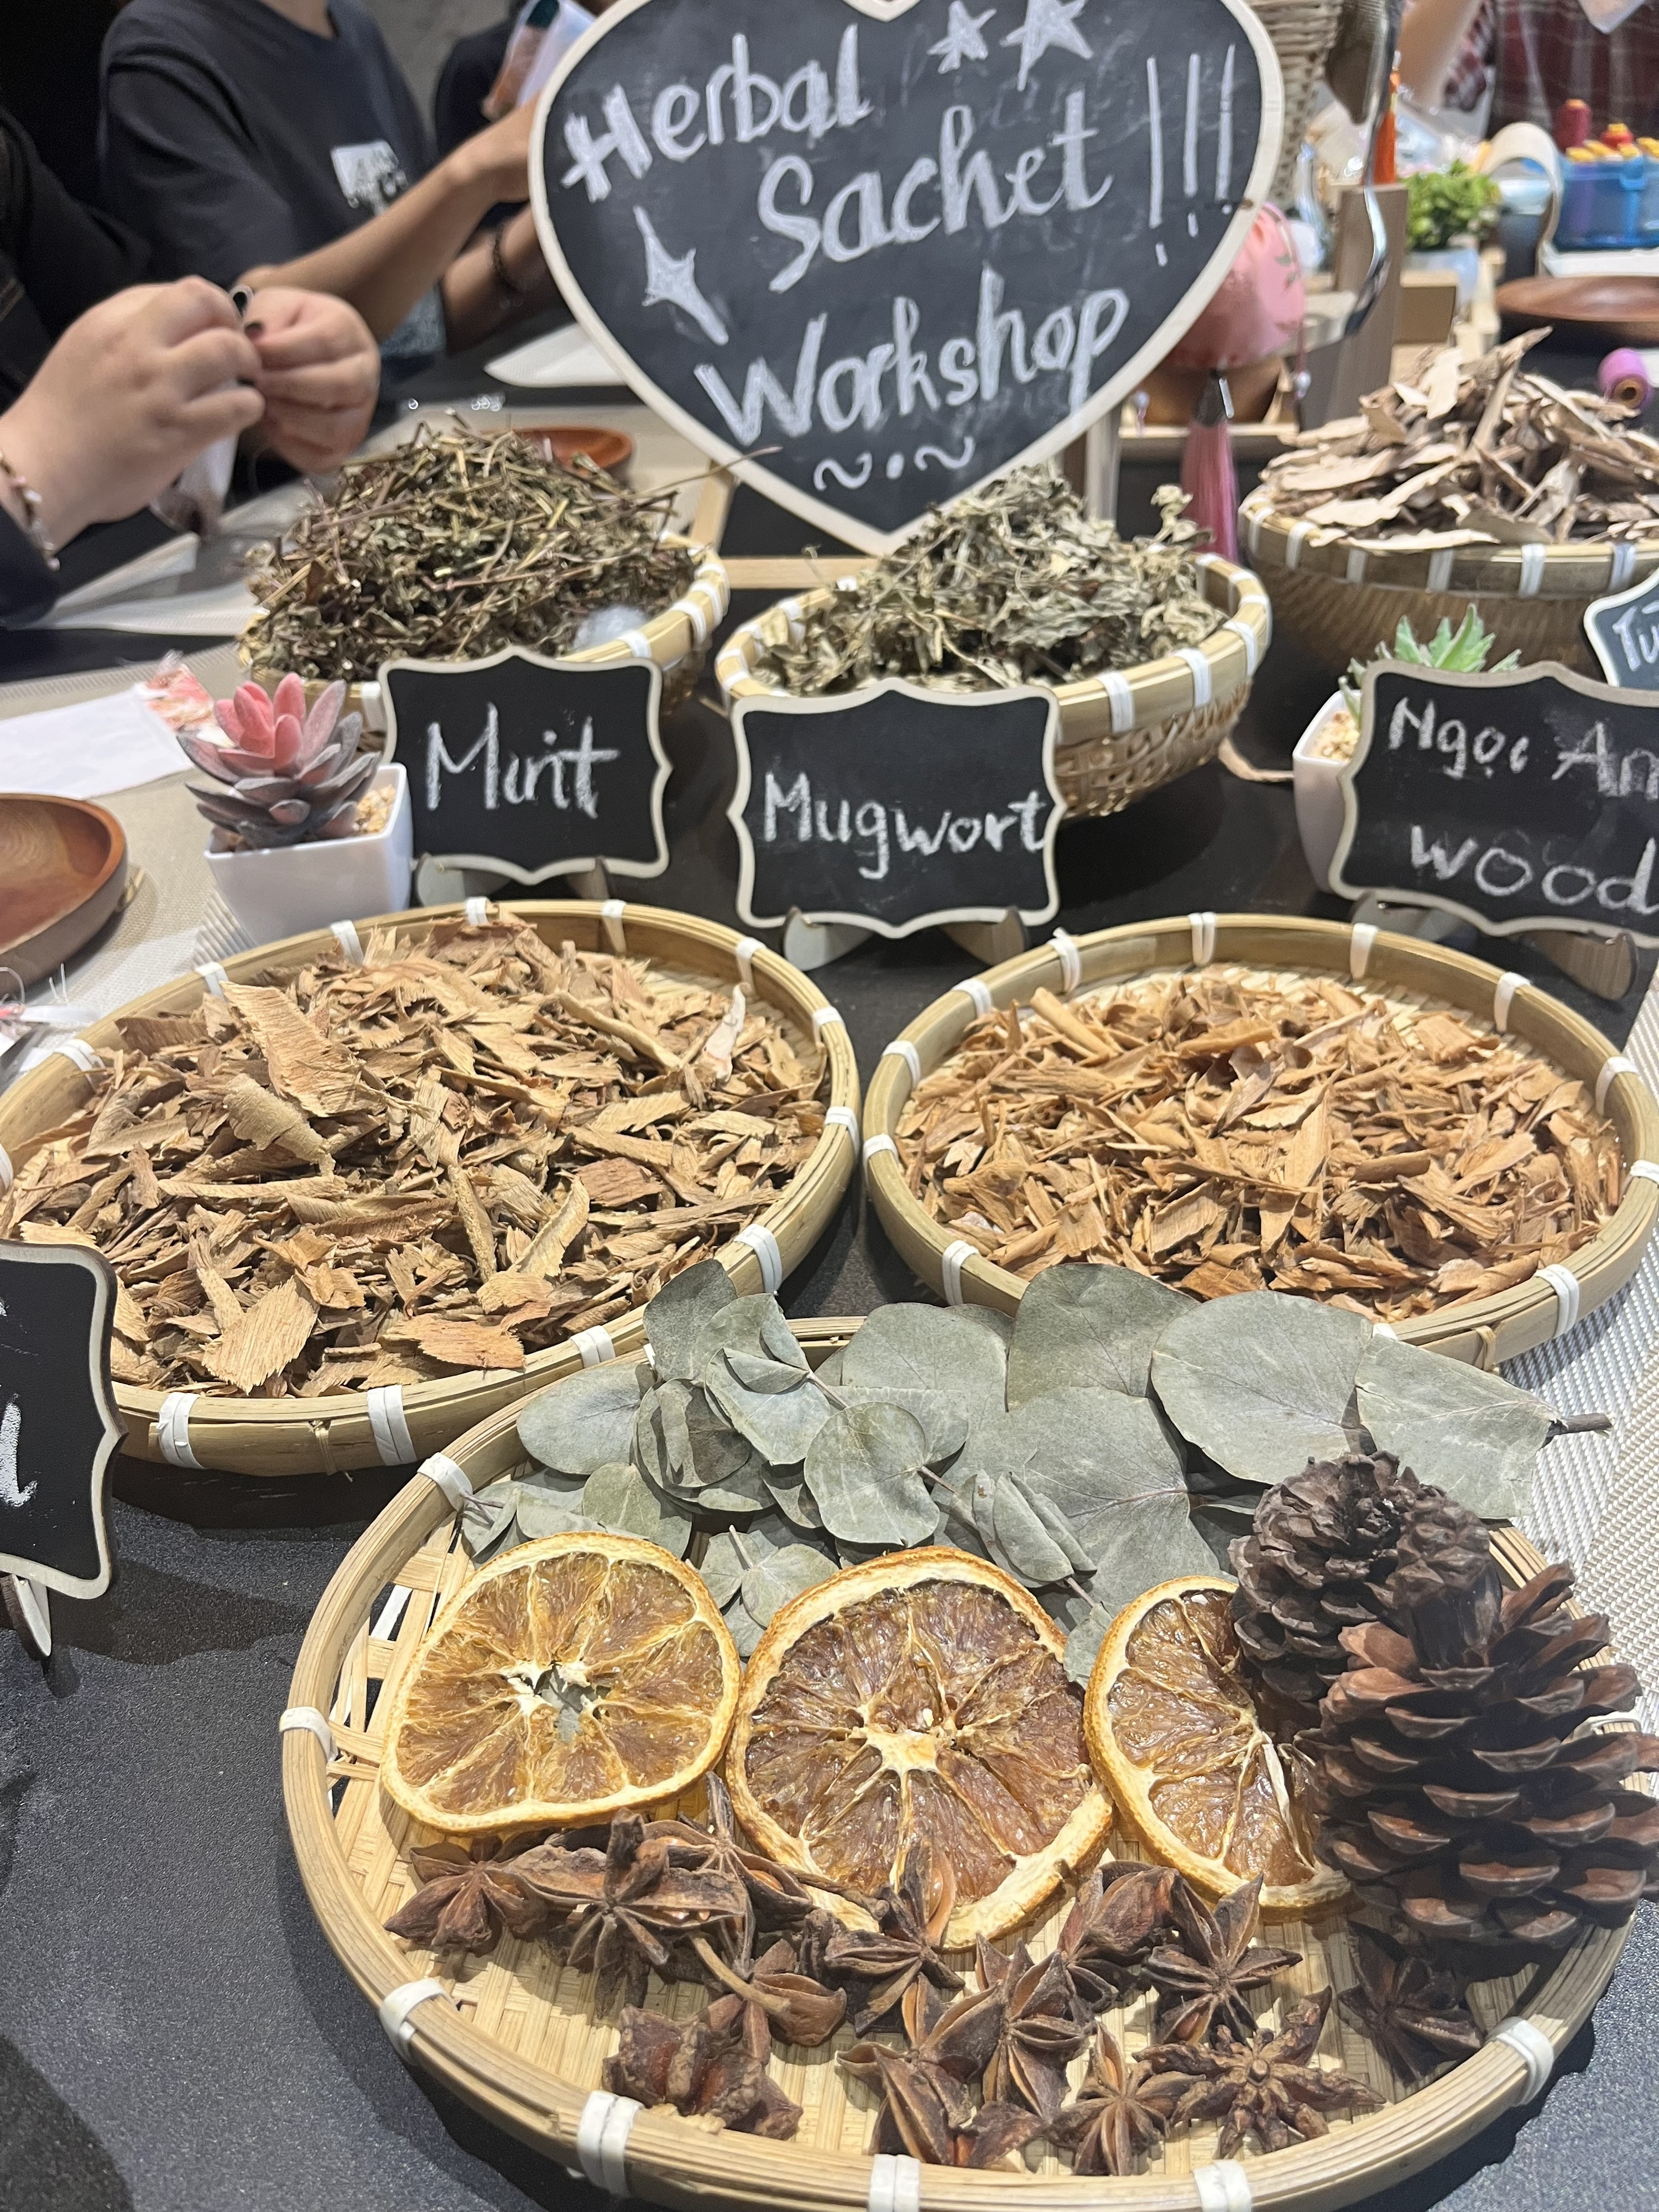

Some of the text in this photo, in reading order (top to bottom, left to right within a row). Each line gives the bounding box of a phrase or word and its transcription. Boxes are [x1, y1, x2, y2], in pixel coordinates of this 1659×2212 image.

[561, 23, 874, 202] Herbal
[758, 90, 1113, 294] Sachet
[693, 261, 1130, 445] Workshop
[425, 701, 620, 819] Mint
[764, 771, 1048, 880] Mugwort
